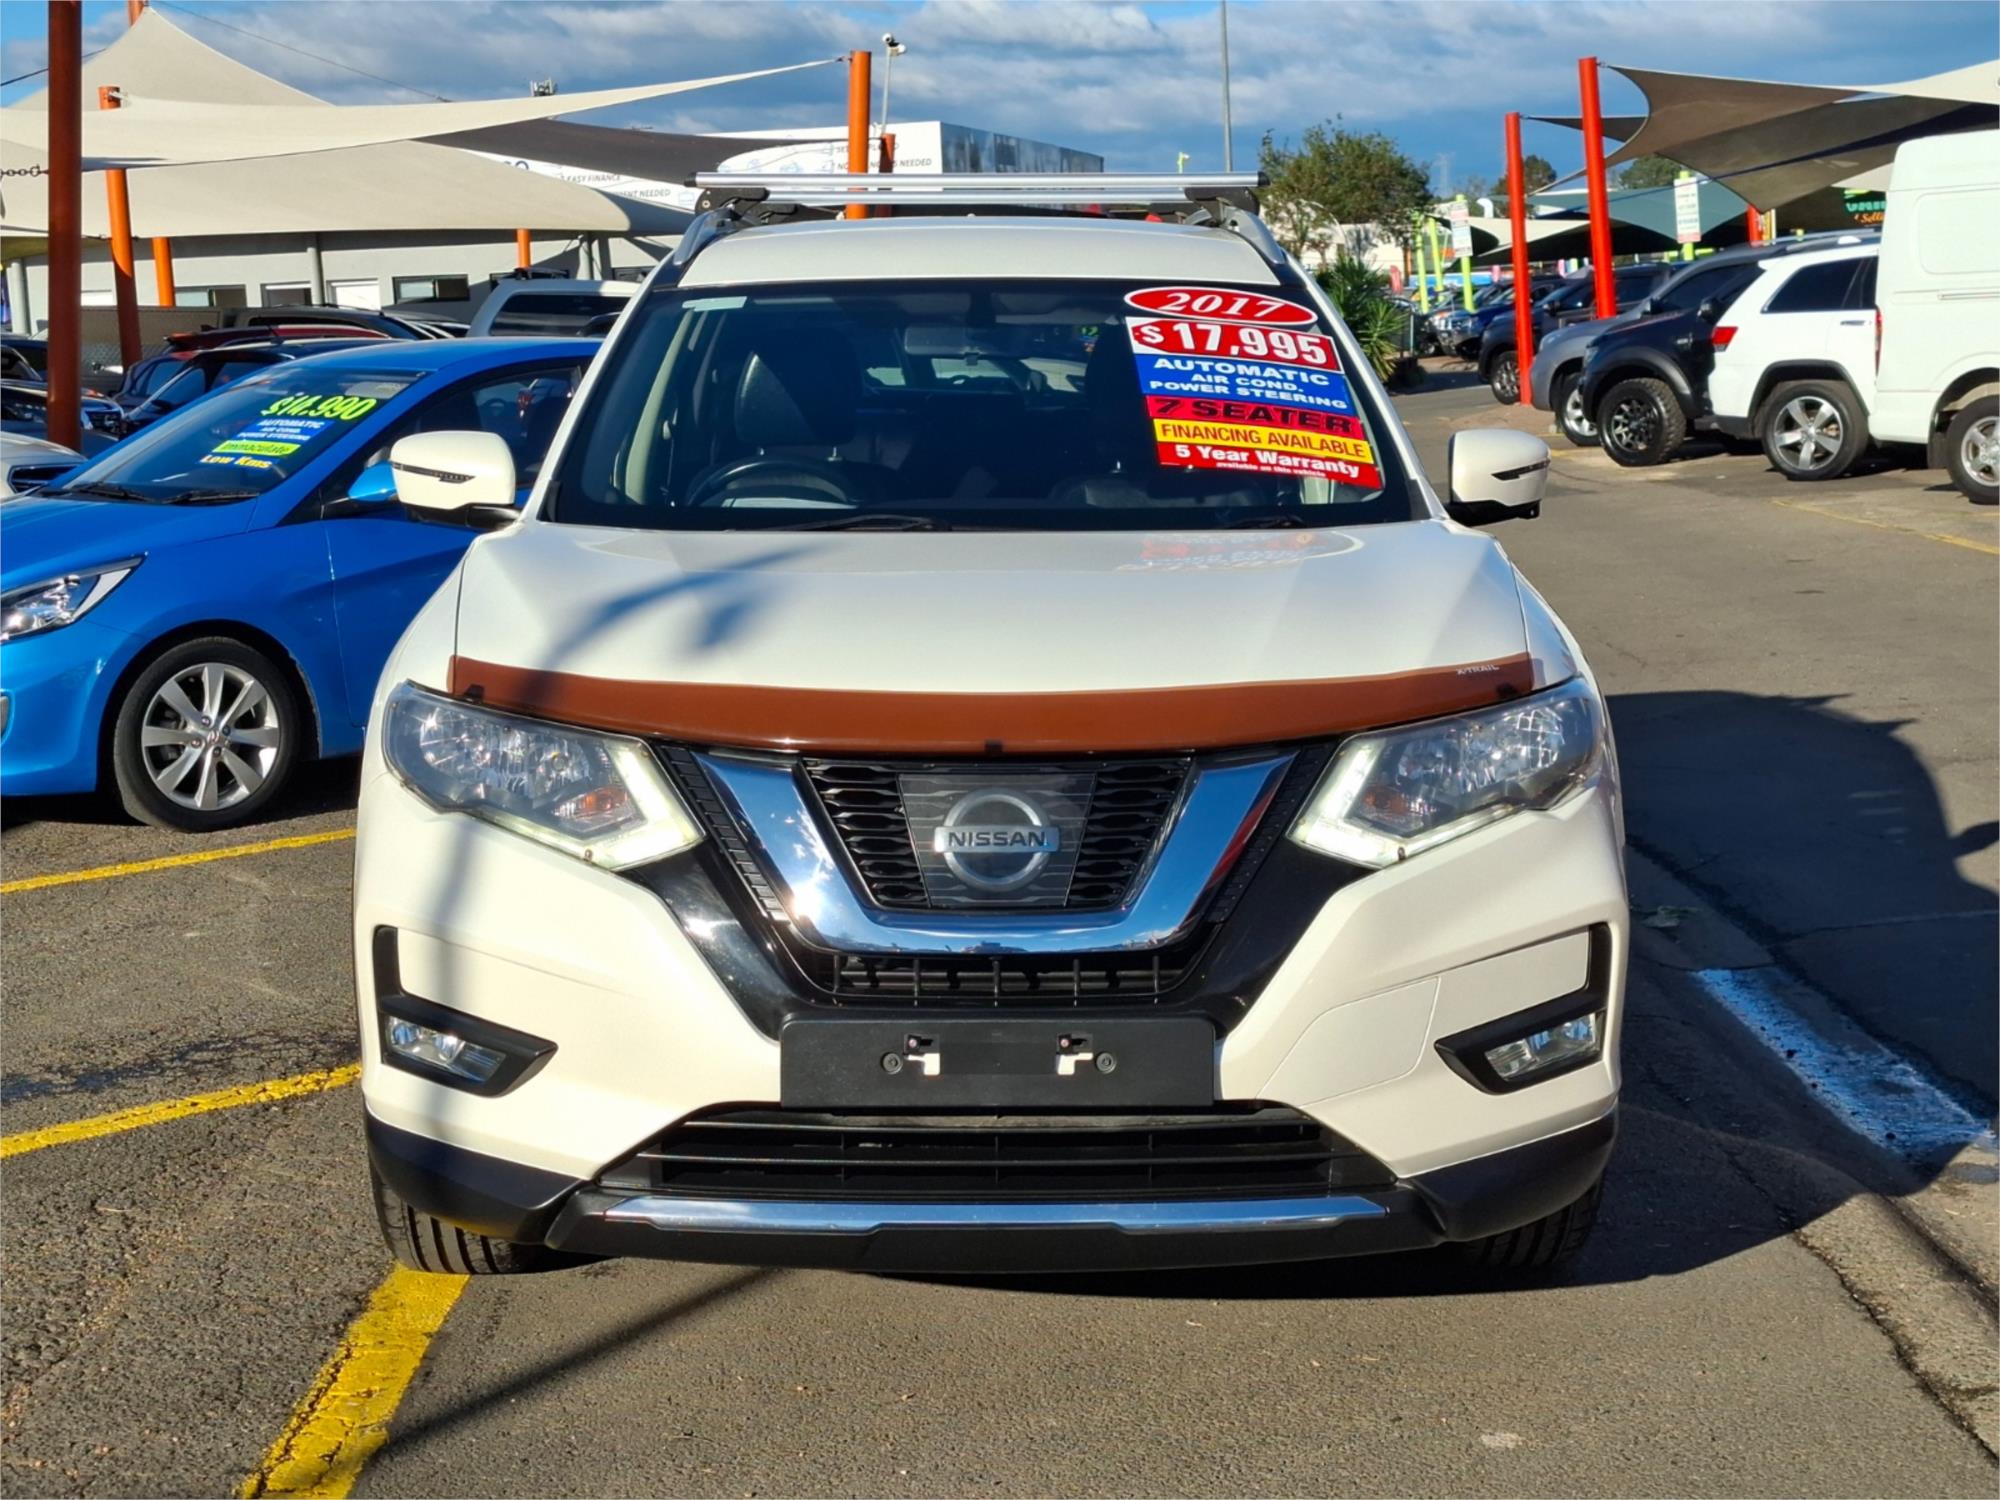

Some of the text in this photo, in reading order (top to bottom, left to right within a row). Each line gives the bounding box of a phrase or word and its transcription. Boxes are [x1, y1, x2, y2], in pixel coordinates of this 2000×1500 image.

[899, 158, 932, 167] NEEDED
[587, 174, 621, 182] FINANCE
[639, 188, 671, 198] NEEDED
[1157, 292, 1286, 318] 2017
[1141, 322, 1327, 365] $17,995
[1154, 358, 1329, 386] AUTOMATIC
[1191, 373, 1304, 393] AIR COND.
[1150, 381, 1348, 409] POWER STEERING
[258, 419, 325, 429] AUTOMATIC
[1155, 399, 1352, 434] 7 SEATER
[266, 432, 311, 441] STEERING
[1161, 423, 1366, 458] FINANCING AVAILABLE
[1175, 444, 1359, 478] 5 Year Warranty
[1216, 462, 1259, 471] available
[1273, 465, 1292, 474] this
[1293, 468, 1326, 477] vehicle
[949, 832, 1048, 847] NISSAN
